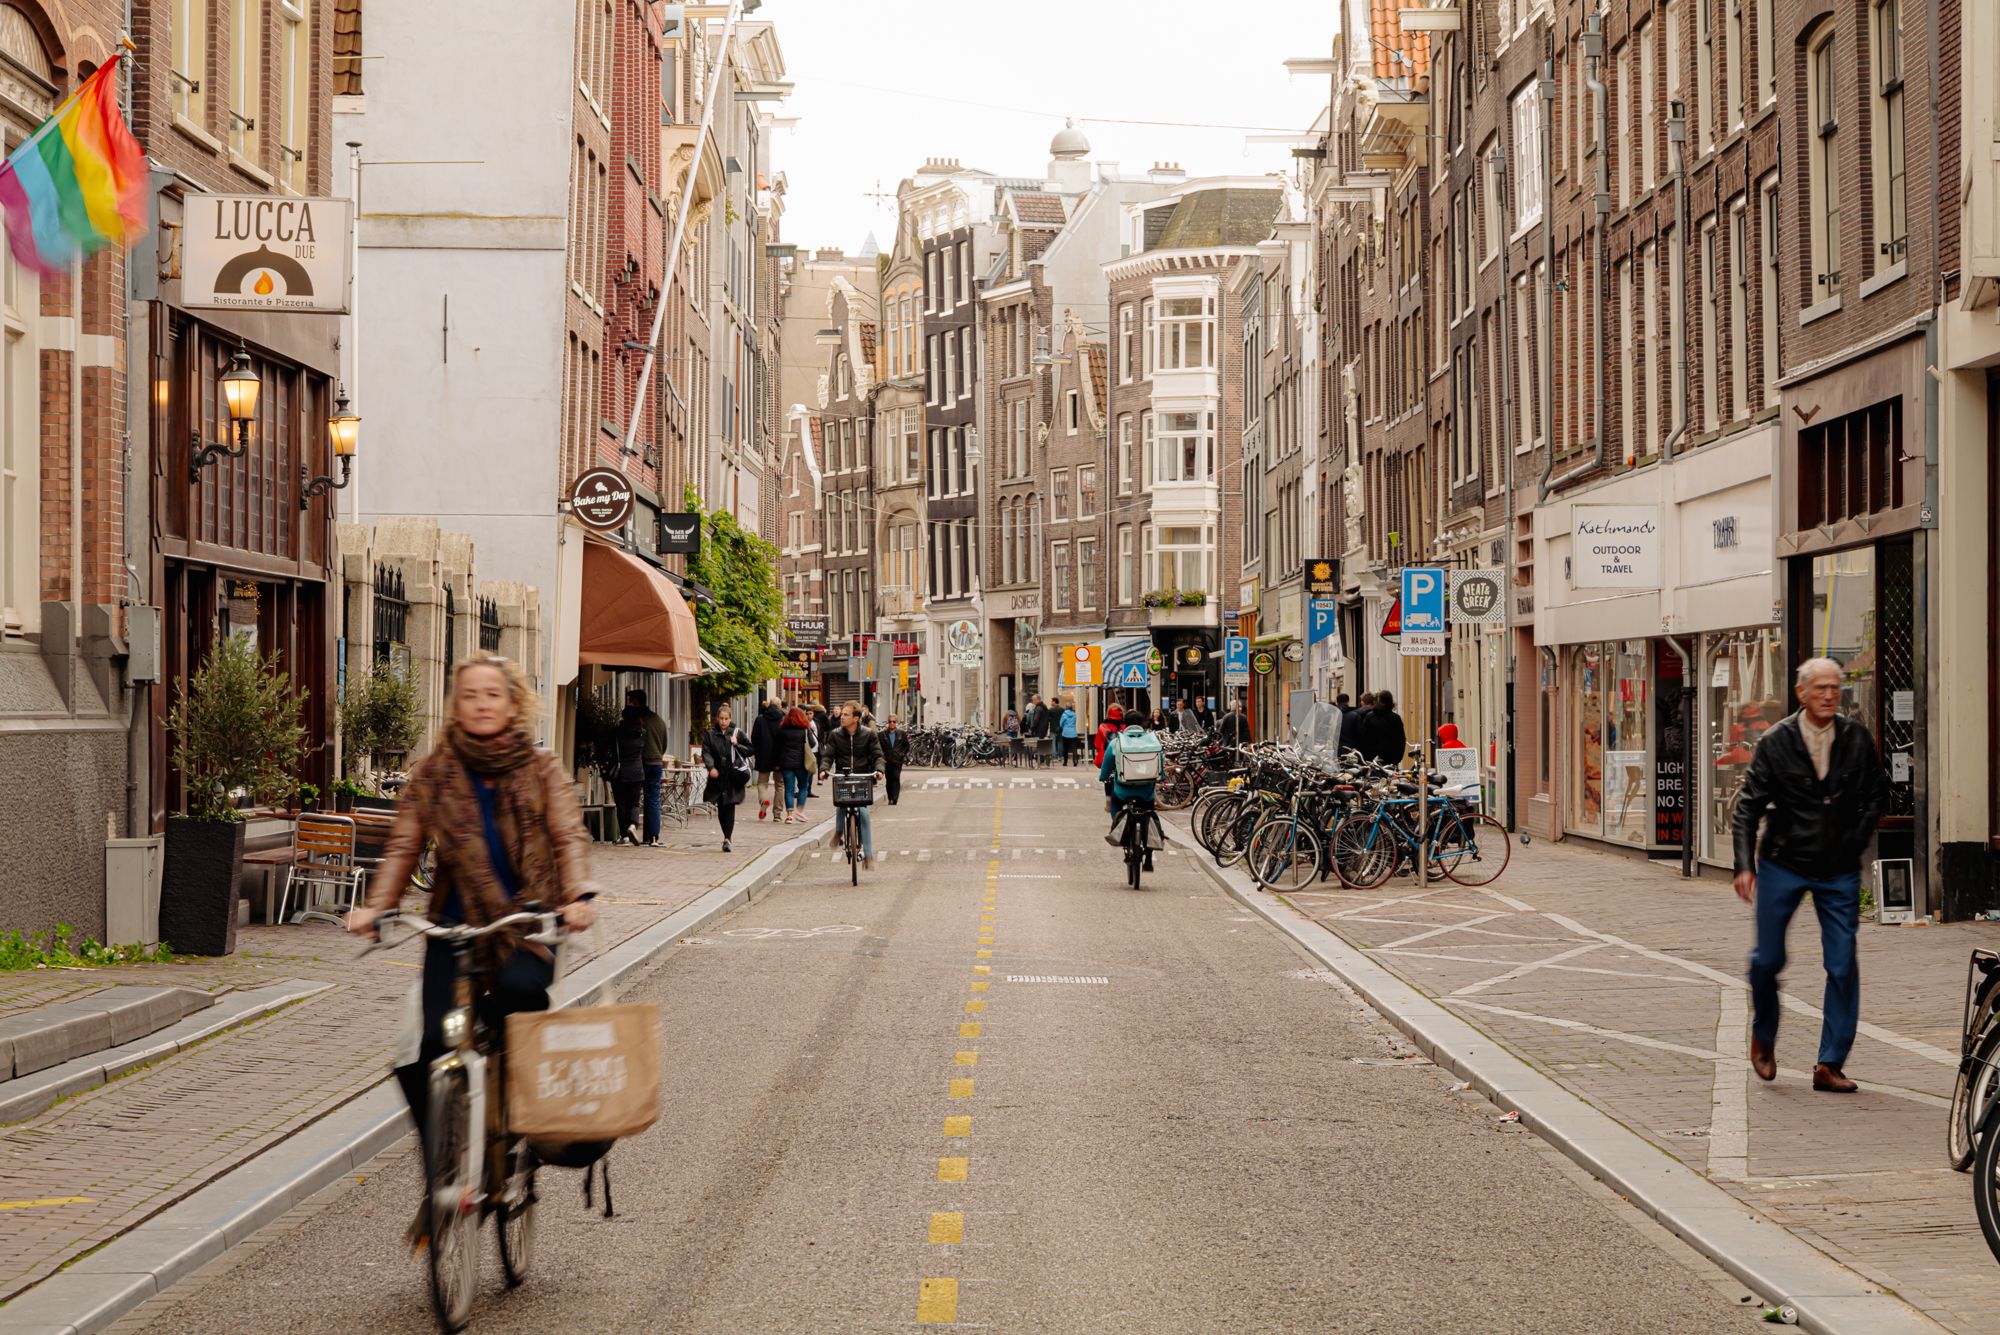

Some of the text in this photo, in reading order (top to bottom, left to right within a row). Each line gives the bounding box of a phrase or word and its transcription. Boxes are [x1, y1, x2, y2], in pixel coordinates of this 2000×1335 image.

[215, 200, 316, 242] LUCCA
[295, 245, 316, 259] DUE
[213, 297, 314, 308] Ristorante & Pizzeria
[573, 491, 630, 507] Bake my Day
[1578, 520, 1656, 535] Kathmandu
[1592, 546, 1641, 555] OUTDOOR
[1601, 565, 1633, 574] TRAVEL
[1411, 574, 1435, 606] P
[1462, 583, 1491, 597] MEAT&
[1462, 594, 1492, 609] GREEK
[790, 621, 825, 630] TE HUUR
[1316, 612, 1328, 631] P
[1410, 637, 1419, 645] MA
[1428, 637, 1436, 645] ZA
[1230, 640, 1245, 659] P
[1657, 779, 1684, 791] BRE
[1657, 796, 1675, 807] NO
[1657, 813, 1669, 824] IN
[1657, 829, 1669, 841] IN
